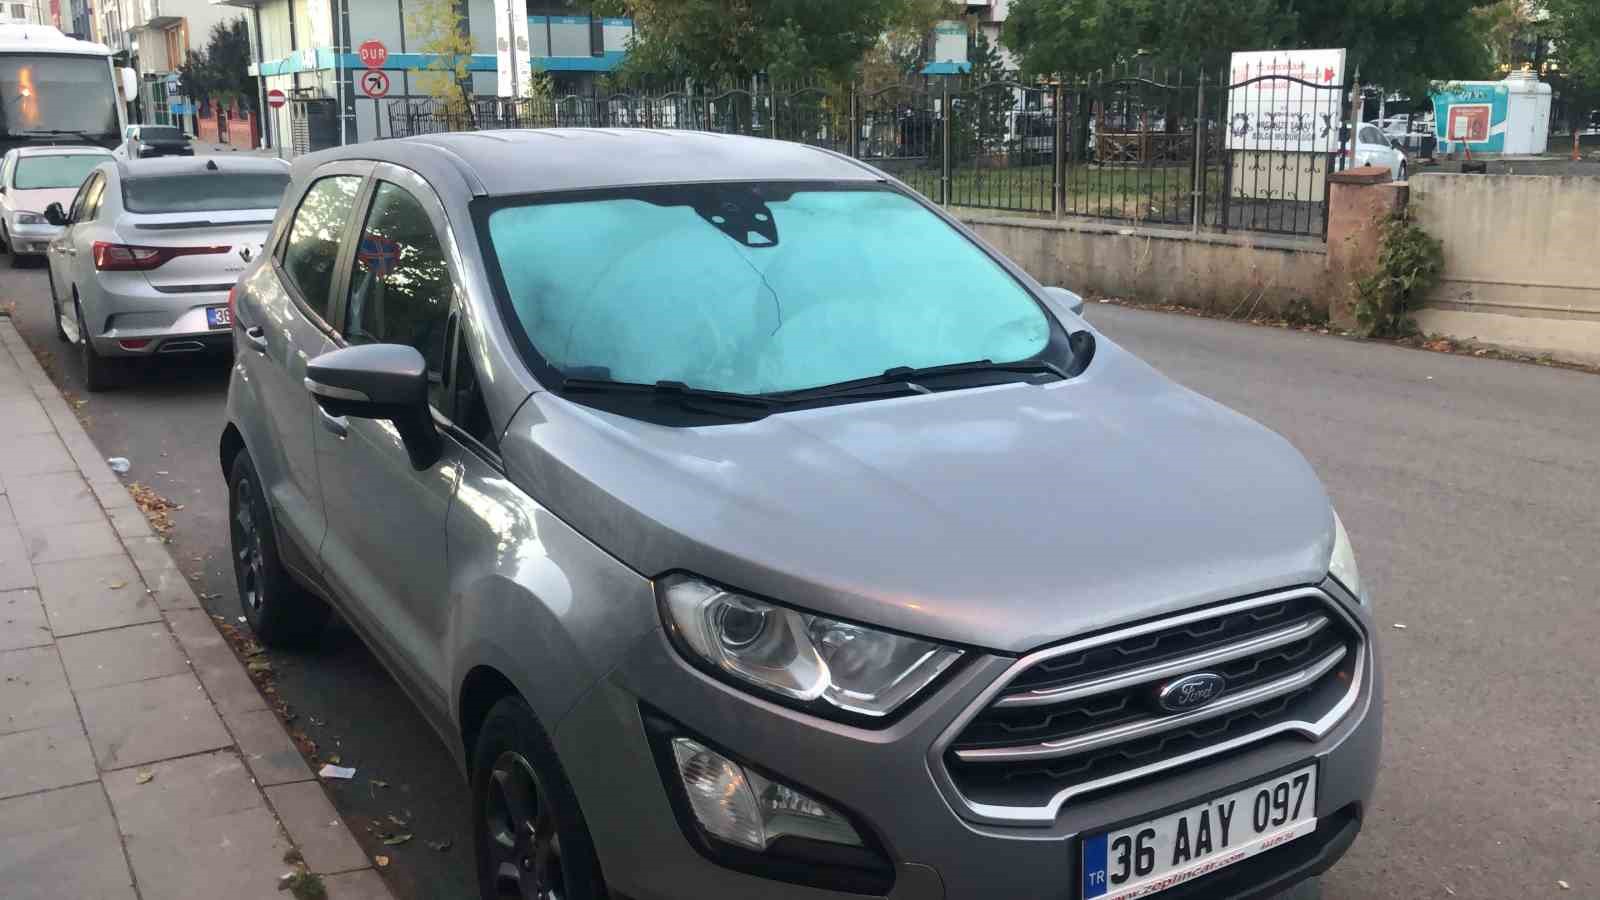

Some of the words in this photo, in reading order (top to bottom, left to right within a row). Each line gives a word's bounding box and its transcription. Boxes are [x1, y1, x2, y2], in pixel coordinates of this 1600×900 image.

[361, 48, 385, 60] DUR
[1179, 681, 1213, 704] Ford
[1110, 829, 1155, 884] 36
[1172, 801, 1235, 866] AAY
[1253, 773, 1309, 833] 097
[1088, 870, 1105, 887] TR
